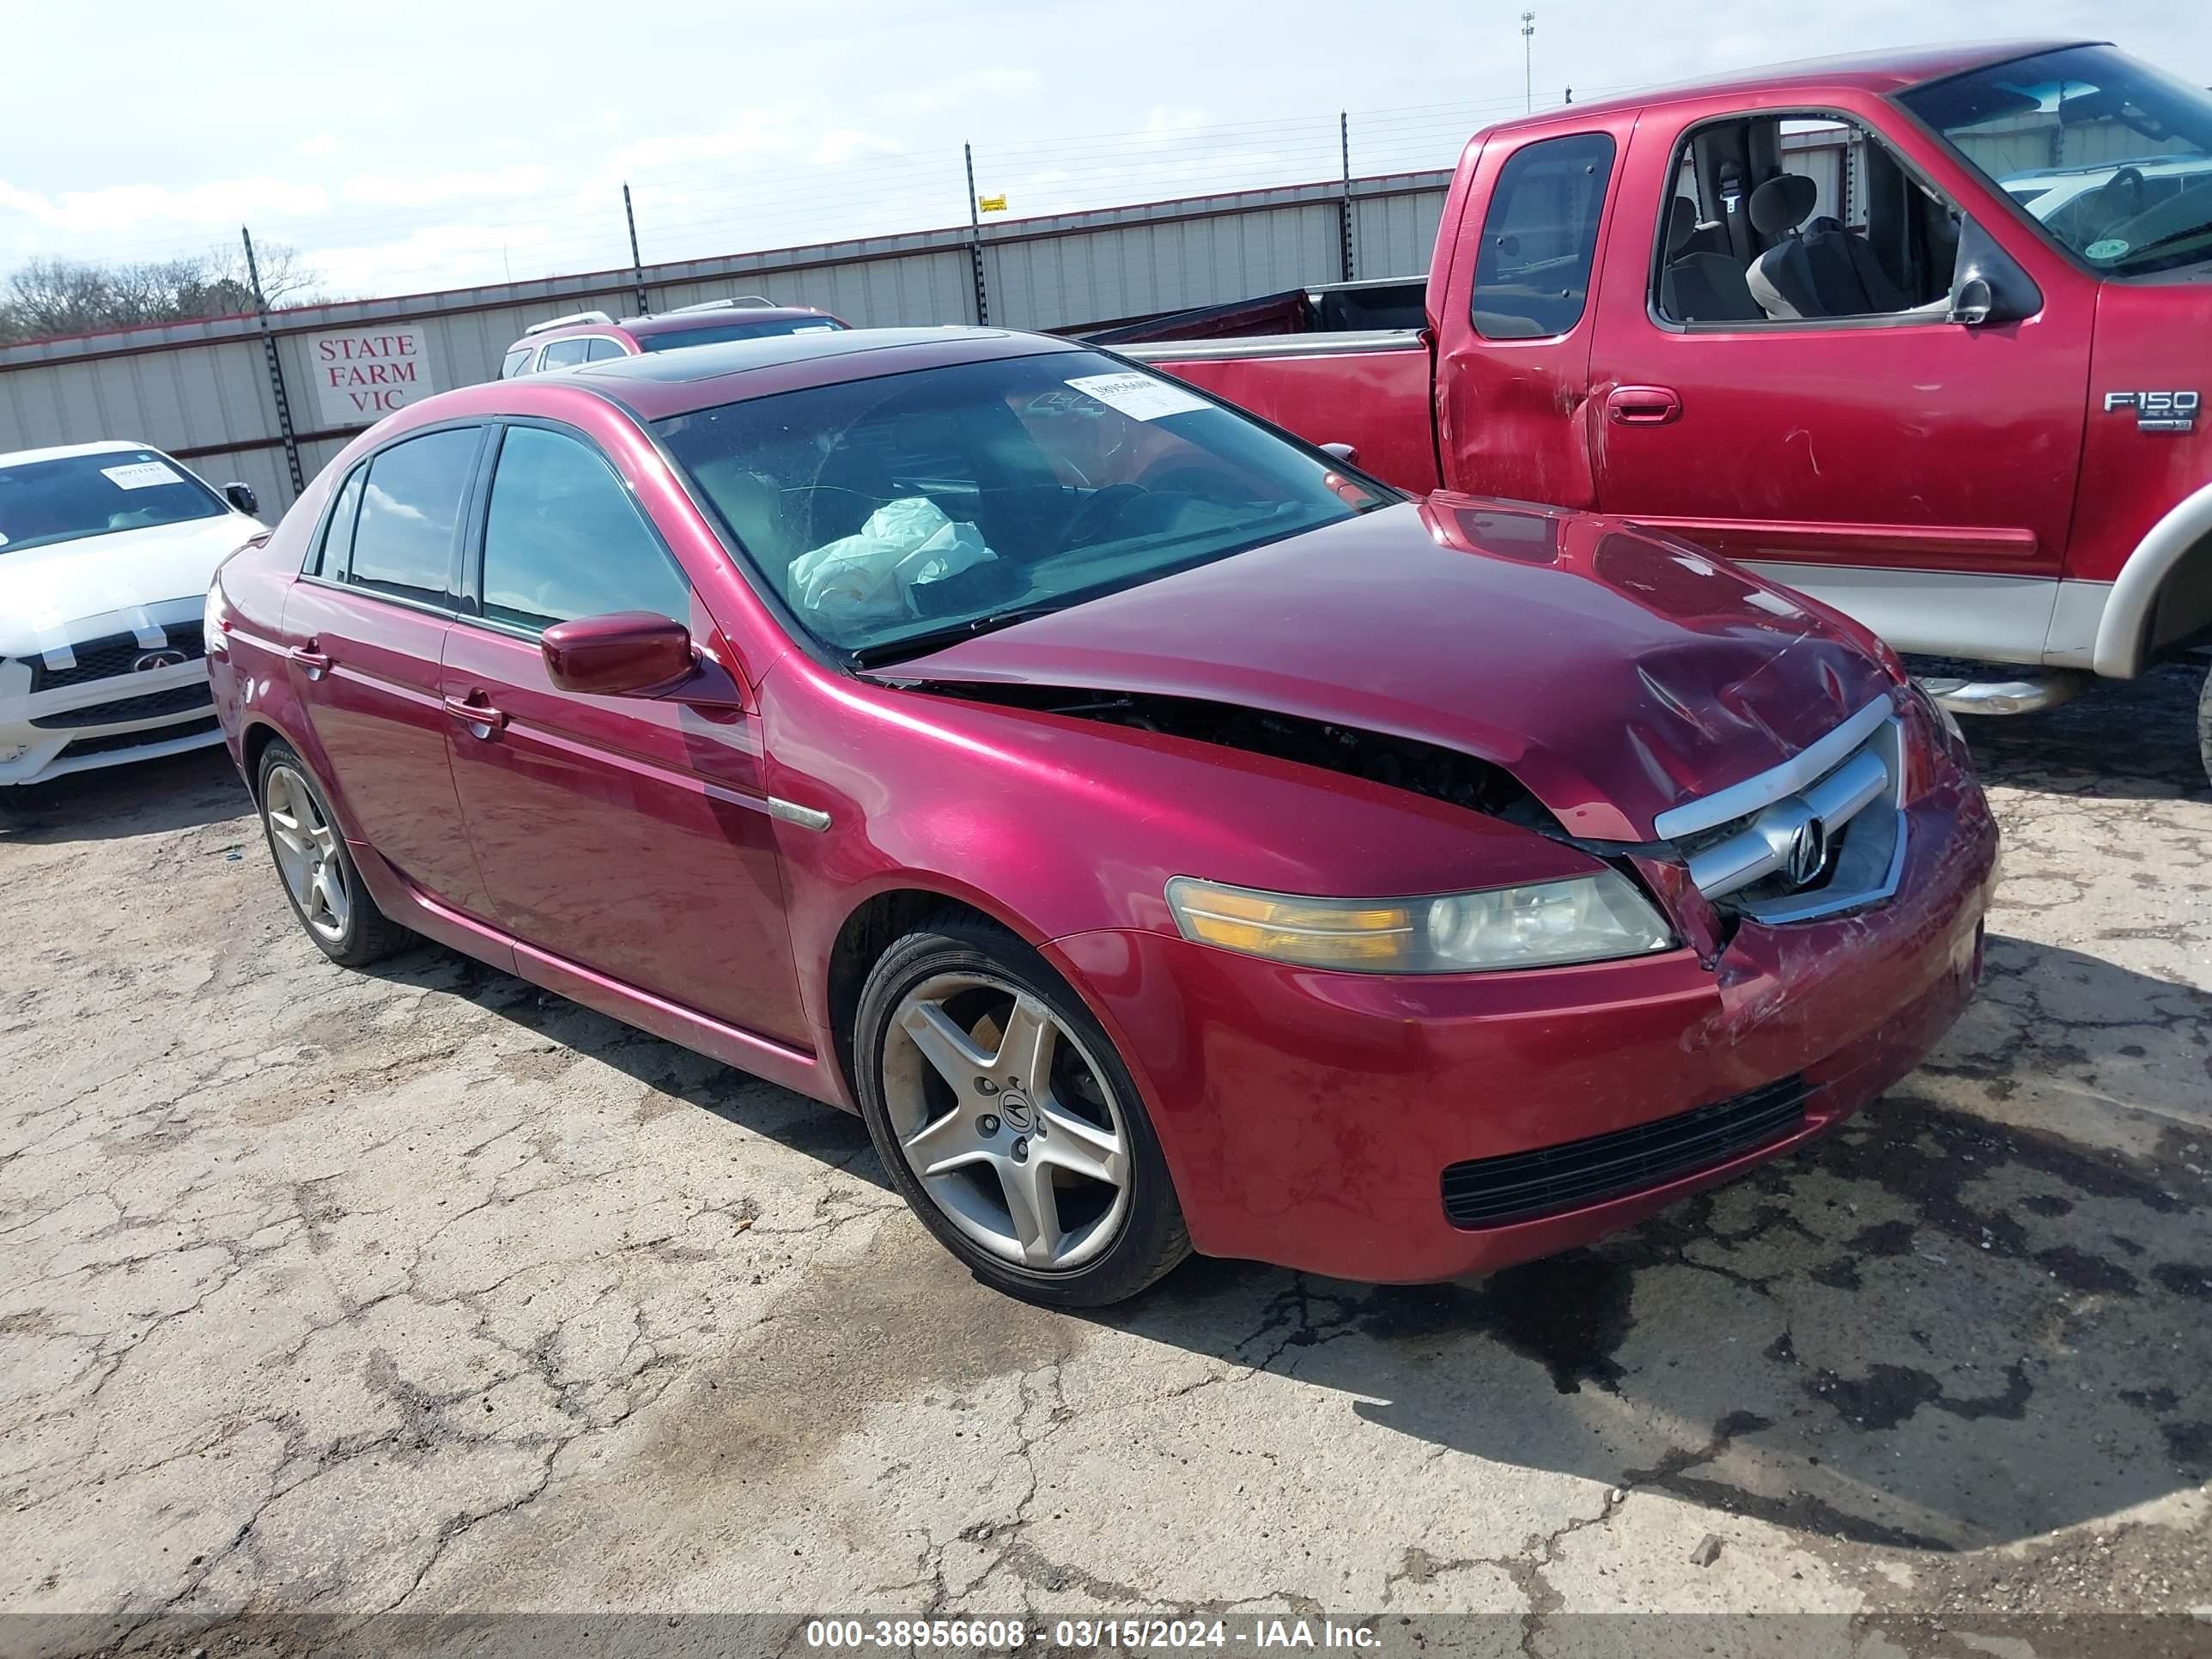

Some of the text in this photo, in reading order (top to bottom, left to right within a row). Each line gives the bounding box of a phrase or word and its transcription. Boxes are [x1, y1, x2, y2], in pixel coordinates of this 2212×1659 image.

[319, 334, 417, 361] STATE
[327, 361, 417, 387] FARM
[349, 389, 405, 412] VIC
